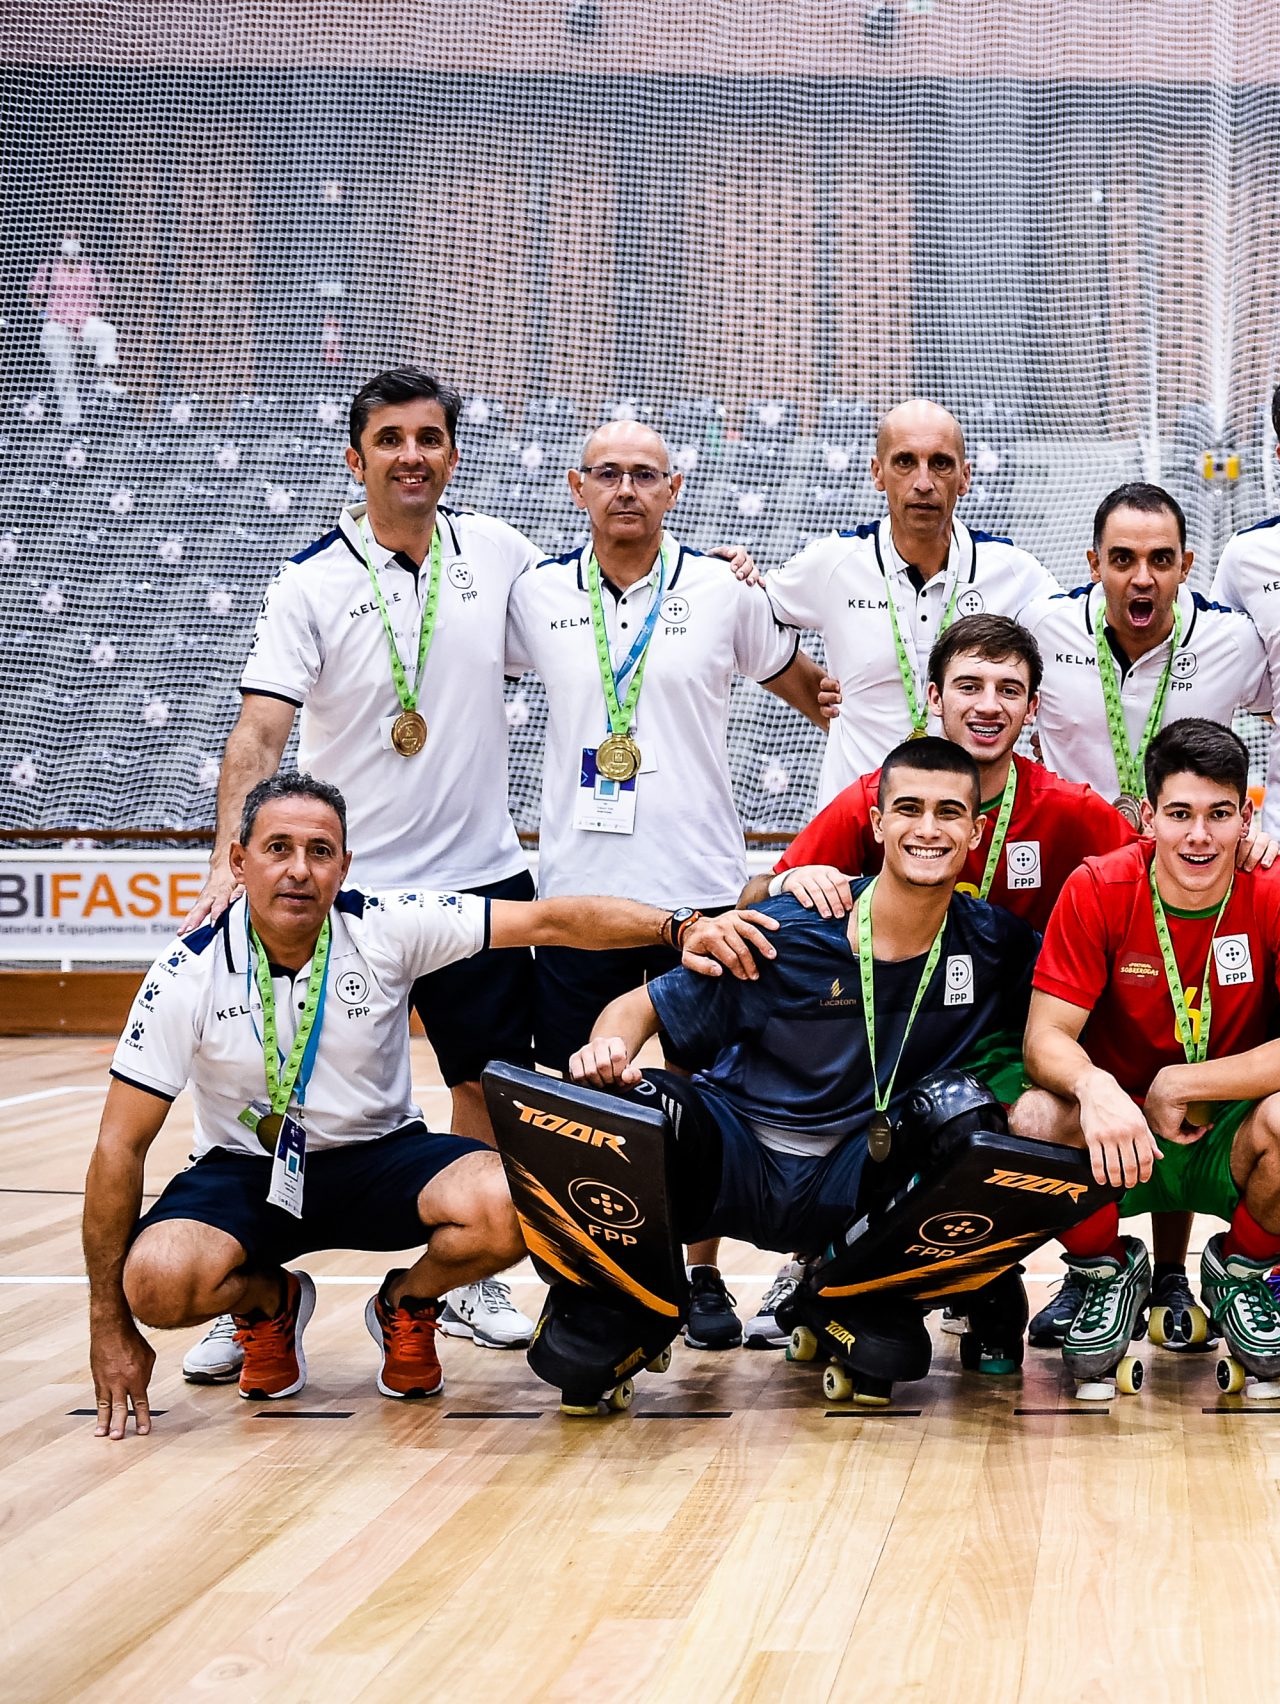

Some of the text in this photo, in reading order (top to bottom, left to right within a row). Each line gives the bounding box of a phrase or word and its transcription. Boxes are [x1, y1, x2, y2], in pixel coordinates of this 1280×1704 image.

[461, 590, 478, 603] FPP
[350, 592, 401, 618] KELE
[848, 599, 889, 610] KELM
[550, 616, 591, 630] KELM
[665, 626, 687, 636] FPP
[1055, 653, 1096, 666] KELM
[1171, 681, 1192, 691] FPP
[1014, 877, 1035, 888] FPP
[1225, 972, 1247, 983] FPP
[950, 993, 967, 1004] FPP
[347, 1006, 371, 1019] FPP
[1174, 987, 1201, 1044] 6
[124, 1038, 145, 1051] ELME
[588, 1224, 638, 1246] FPP
[904, 1244, 956, 1259] FPP
